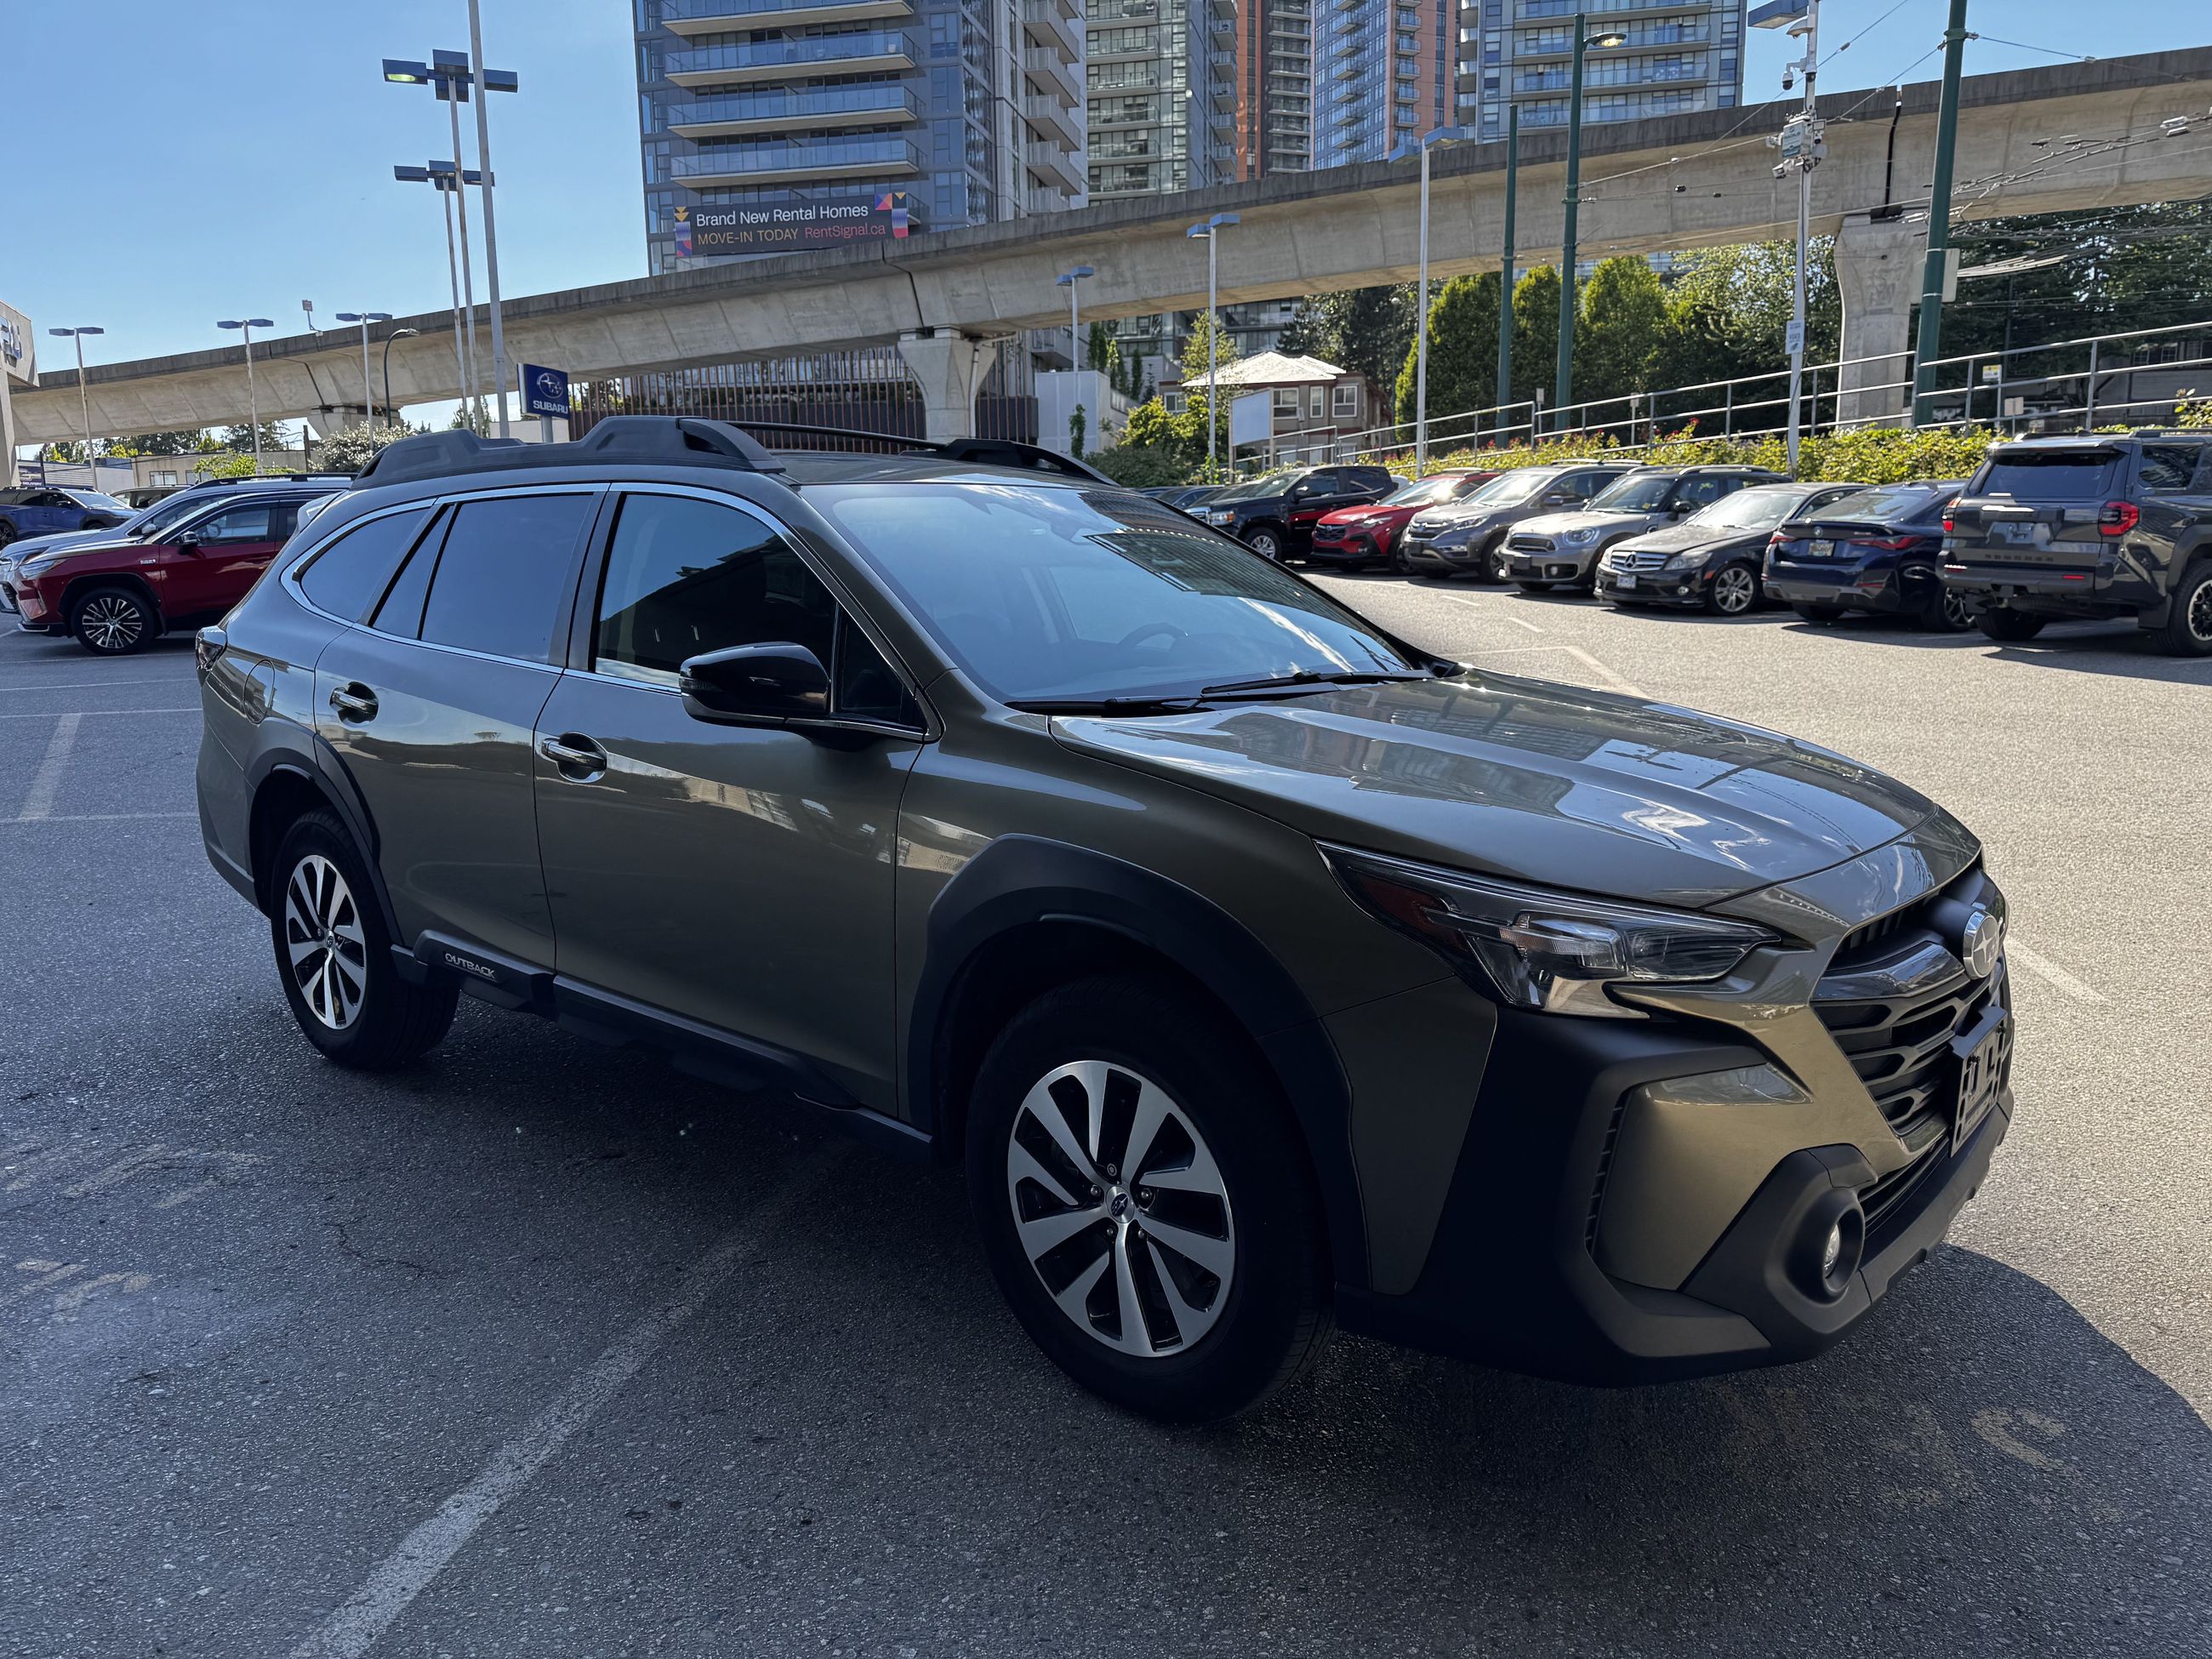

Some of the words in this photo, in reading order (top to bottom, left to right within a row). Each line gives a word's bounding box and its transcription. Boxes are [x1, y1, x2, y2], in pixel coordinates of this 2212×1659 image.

[697, 211, 735, 226] Brand
[740, 211, 769, 224] New
[773, 205, 815, 222] Rental
[820, 206, 868, 219] Homes
[698, 231, 753, 245] MOVE-IN
[757, 228, 798, 242] TODAY
[805, 223, 886, 238] RentSignal.ca
[533, 400, 568, 414] SUBARU
[445, 953, 495, 979] OUTBACK
